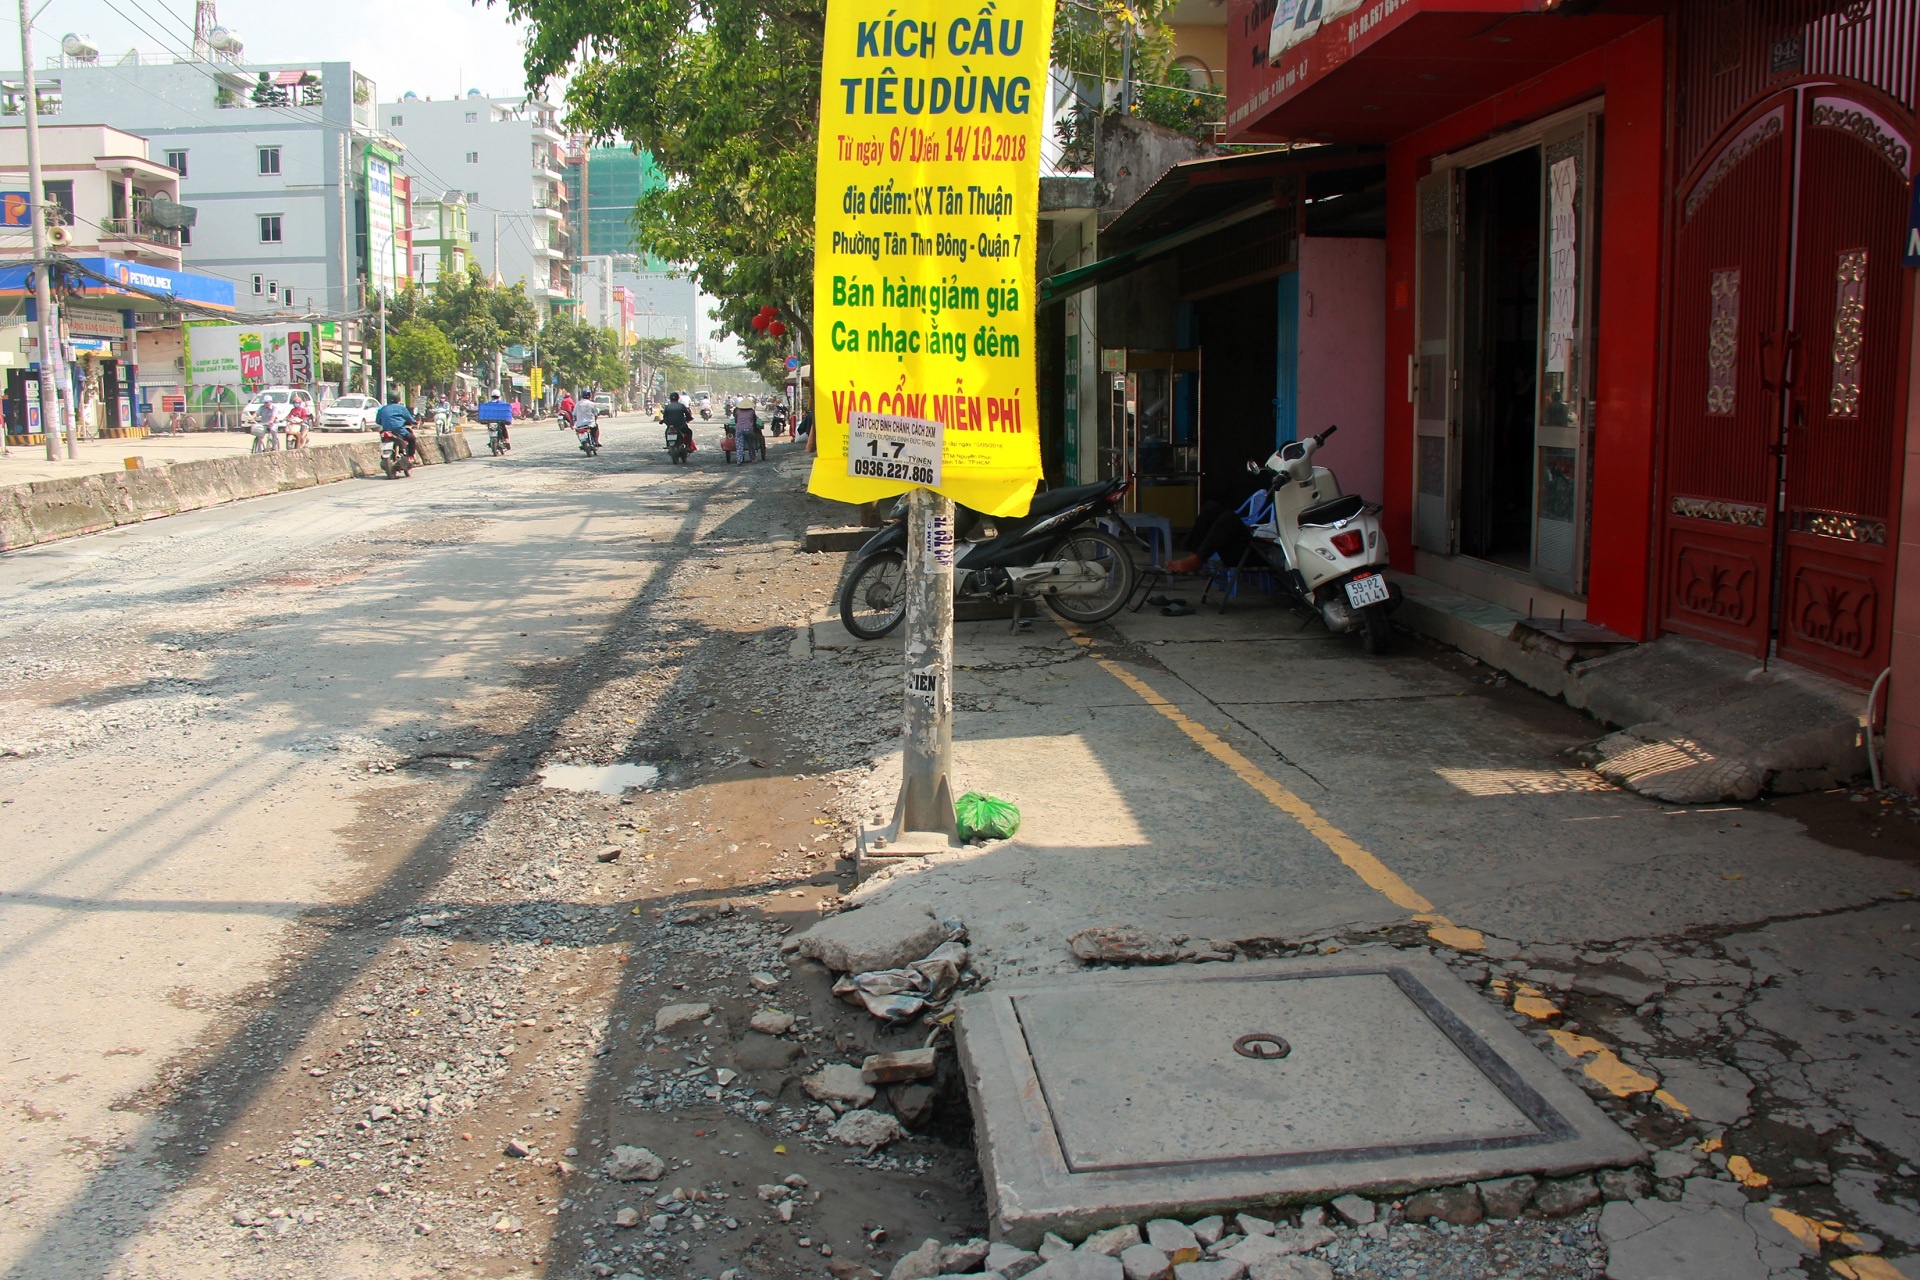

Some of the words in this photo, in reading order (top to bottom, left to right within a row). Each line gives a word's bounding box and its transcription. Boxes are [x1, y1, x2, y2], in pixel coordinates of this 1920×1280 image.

[856, 9, 937, 59] KÍCH
[947, 1, 1024, 57] CẦU
[837, 135, 854, 162] Từ
[856, 134, 884, 167] ngày
[843, 185, 864, 220] địa
[870, 178, 912, 215] điểm:
[937, 186, 963, 216] Tân
[968, 186, 1013, 222] Thuận
[832, 231, 880, 261] Phường
[883, 231, 908, 256] Tân
[936, 231, 967, 263] Đông
[978, 233, 1010, 261] Quận
[1012, 235, 1021, 258] 7
[130, 272, 172, 290] PETROLIMEX
[832, 274, 874, 307] Bán
[929, 274, 979, 316] giảm
[986, 278, 1019, 318] giá
[831, 320, 859, 352] Ca
[867, 322, 921, 362] nhạc
[974, 325, 1020, 358] đêm
[242, 354, 260, 374] 7up
[292, 342, 308, 383] 7UP
[933, 378, 981, 432] MIỄN
[988, 387, 1021, 433] PHÍ
[867, 439, 905, 459] 1.7
[854, 459, 934, 484] 0936.227.806
[1351, 577, 1379, 595] 59-P2
[1352, 587, 1386, 606] 041.41
